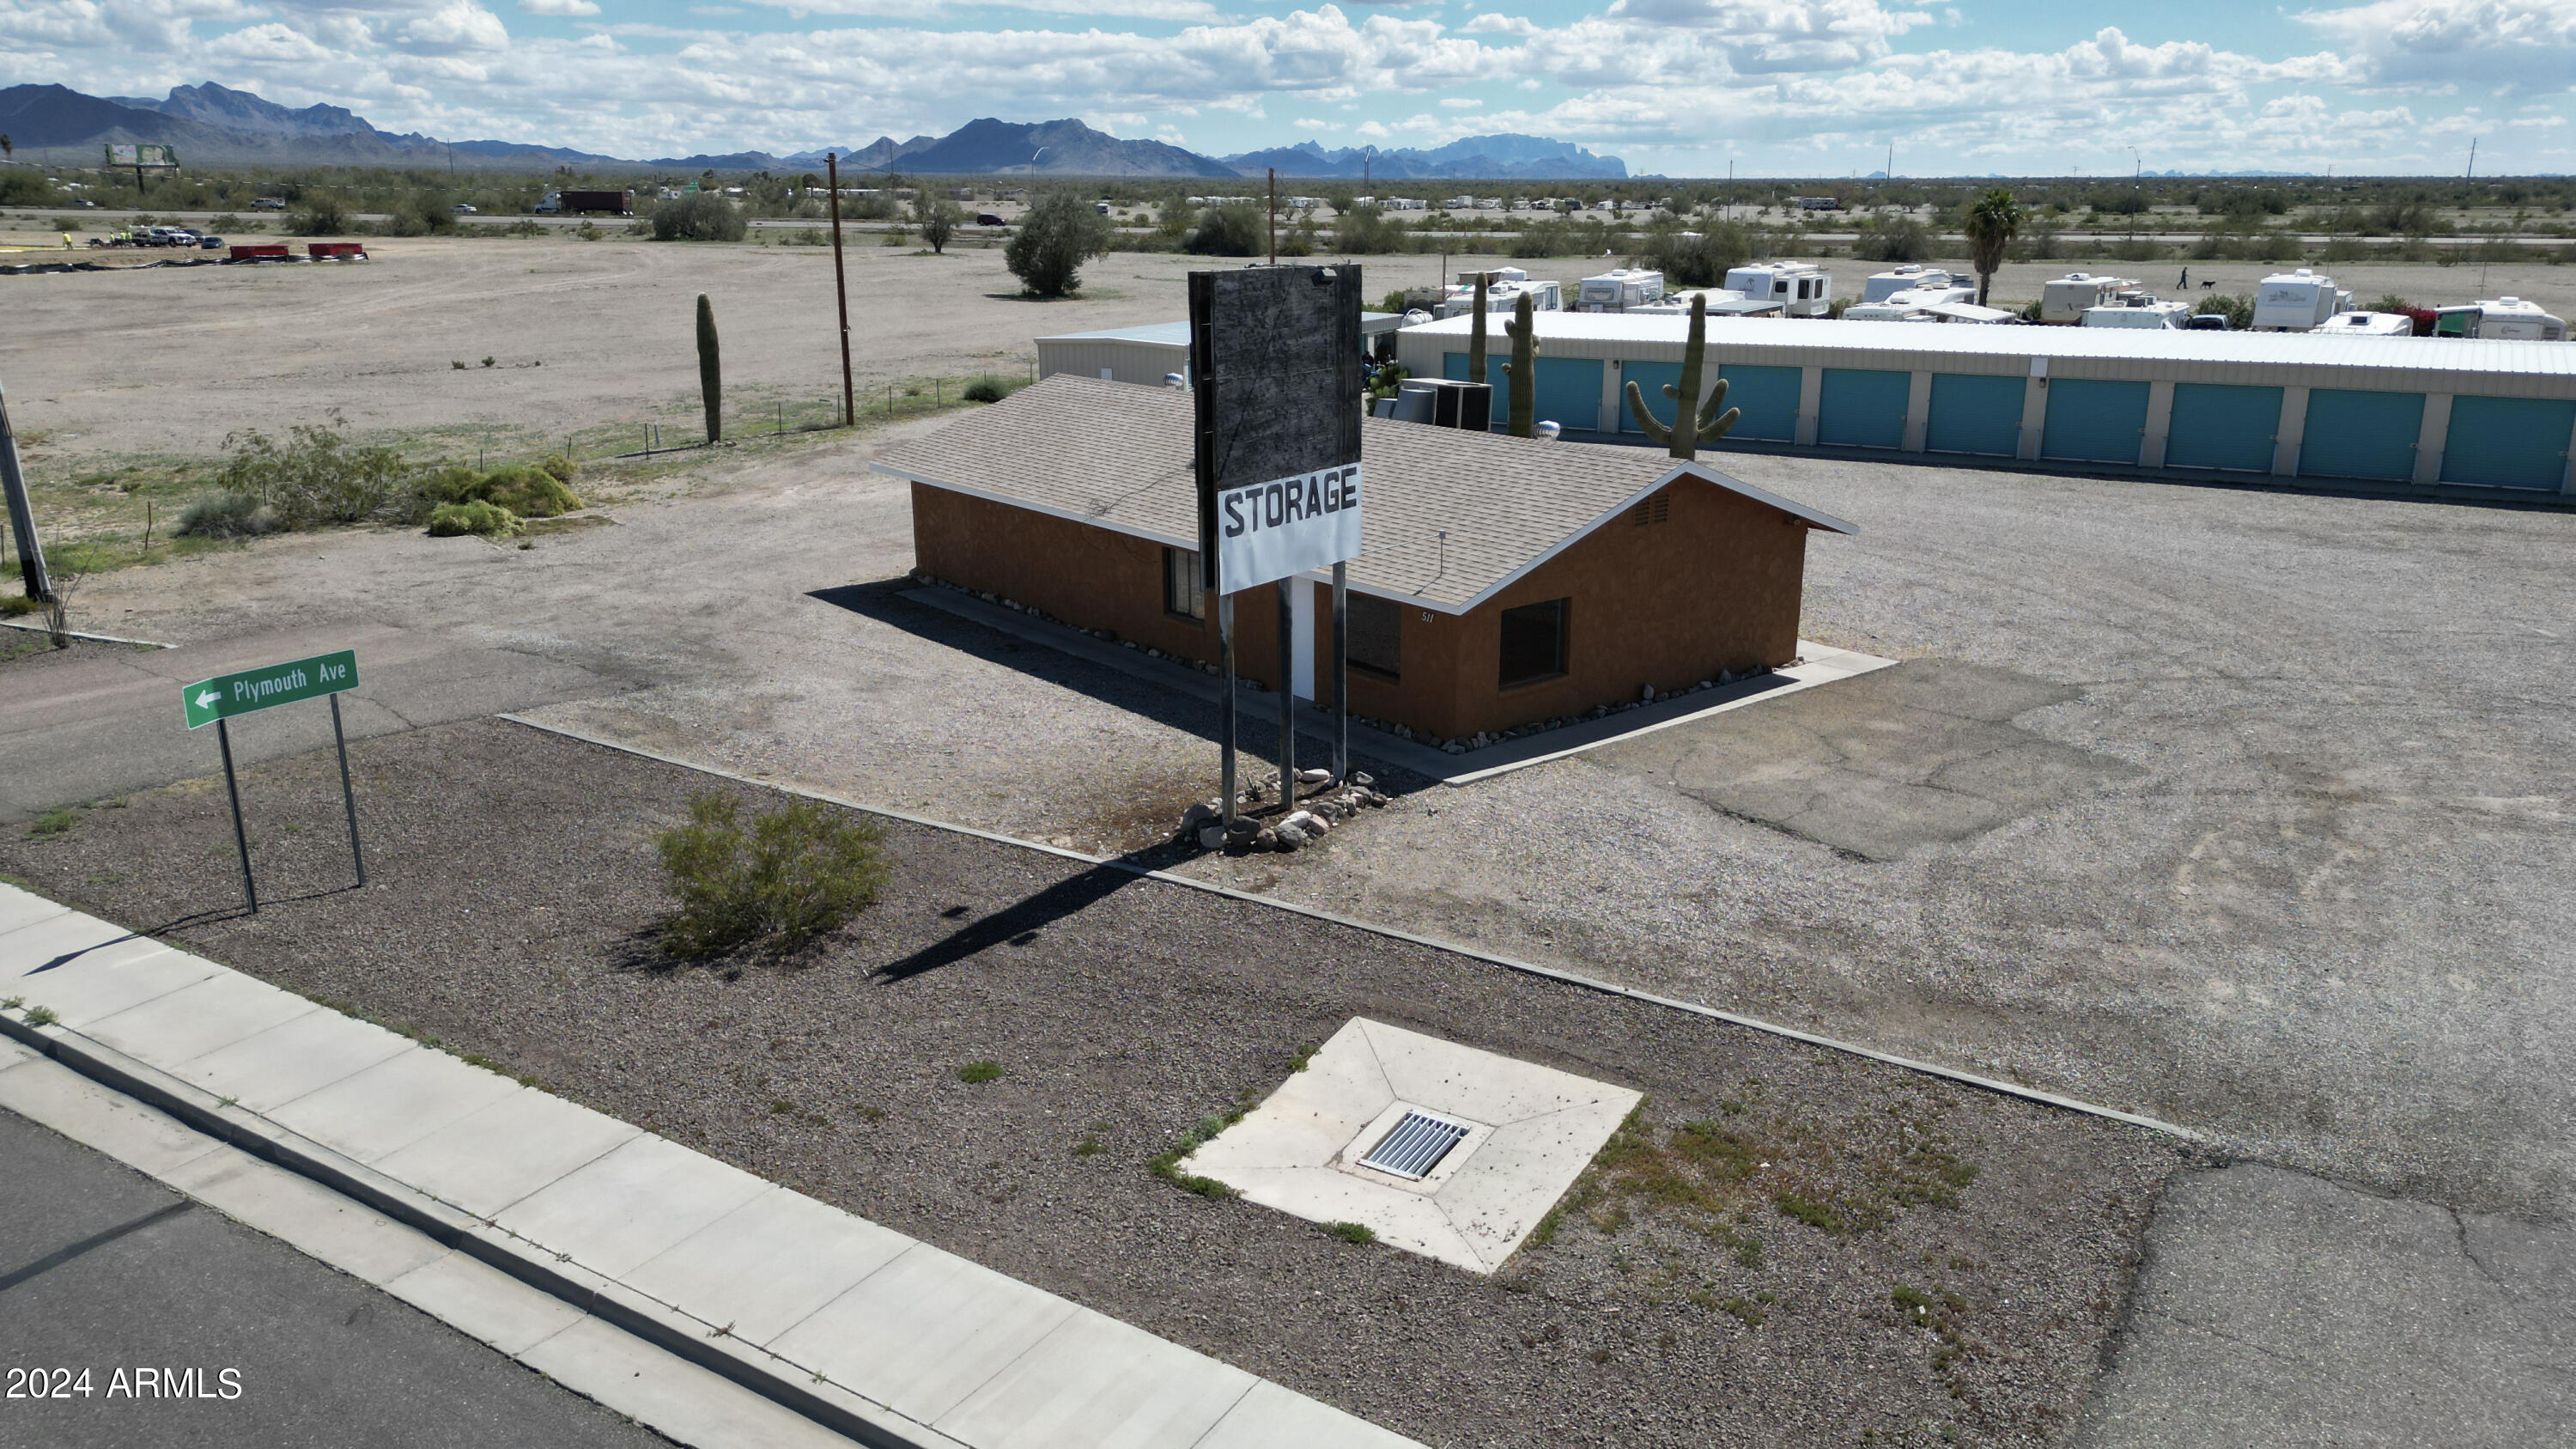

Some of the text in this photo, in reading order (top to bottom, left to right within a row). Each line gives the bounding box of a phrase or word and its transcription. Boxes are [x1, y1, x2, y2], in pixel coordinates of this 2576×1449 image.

[1224, 466, 1358, 538] STORAGE
[1421, 612, 1434, 624] 511
[234, 662, 346, 703] Plymouth Ave
